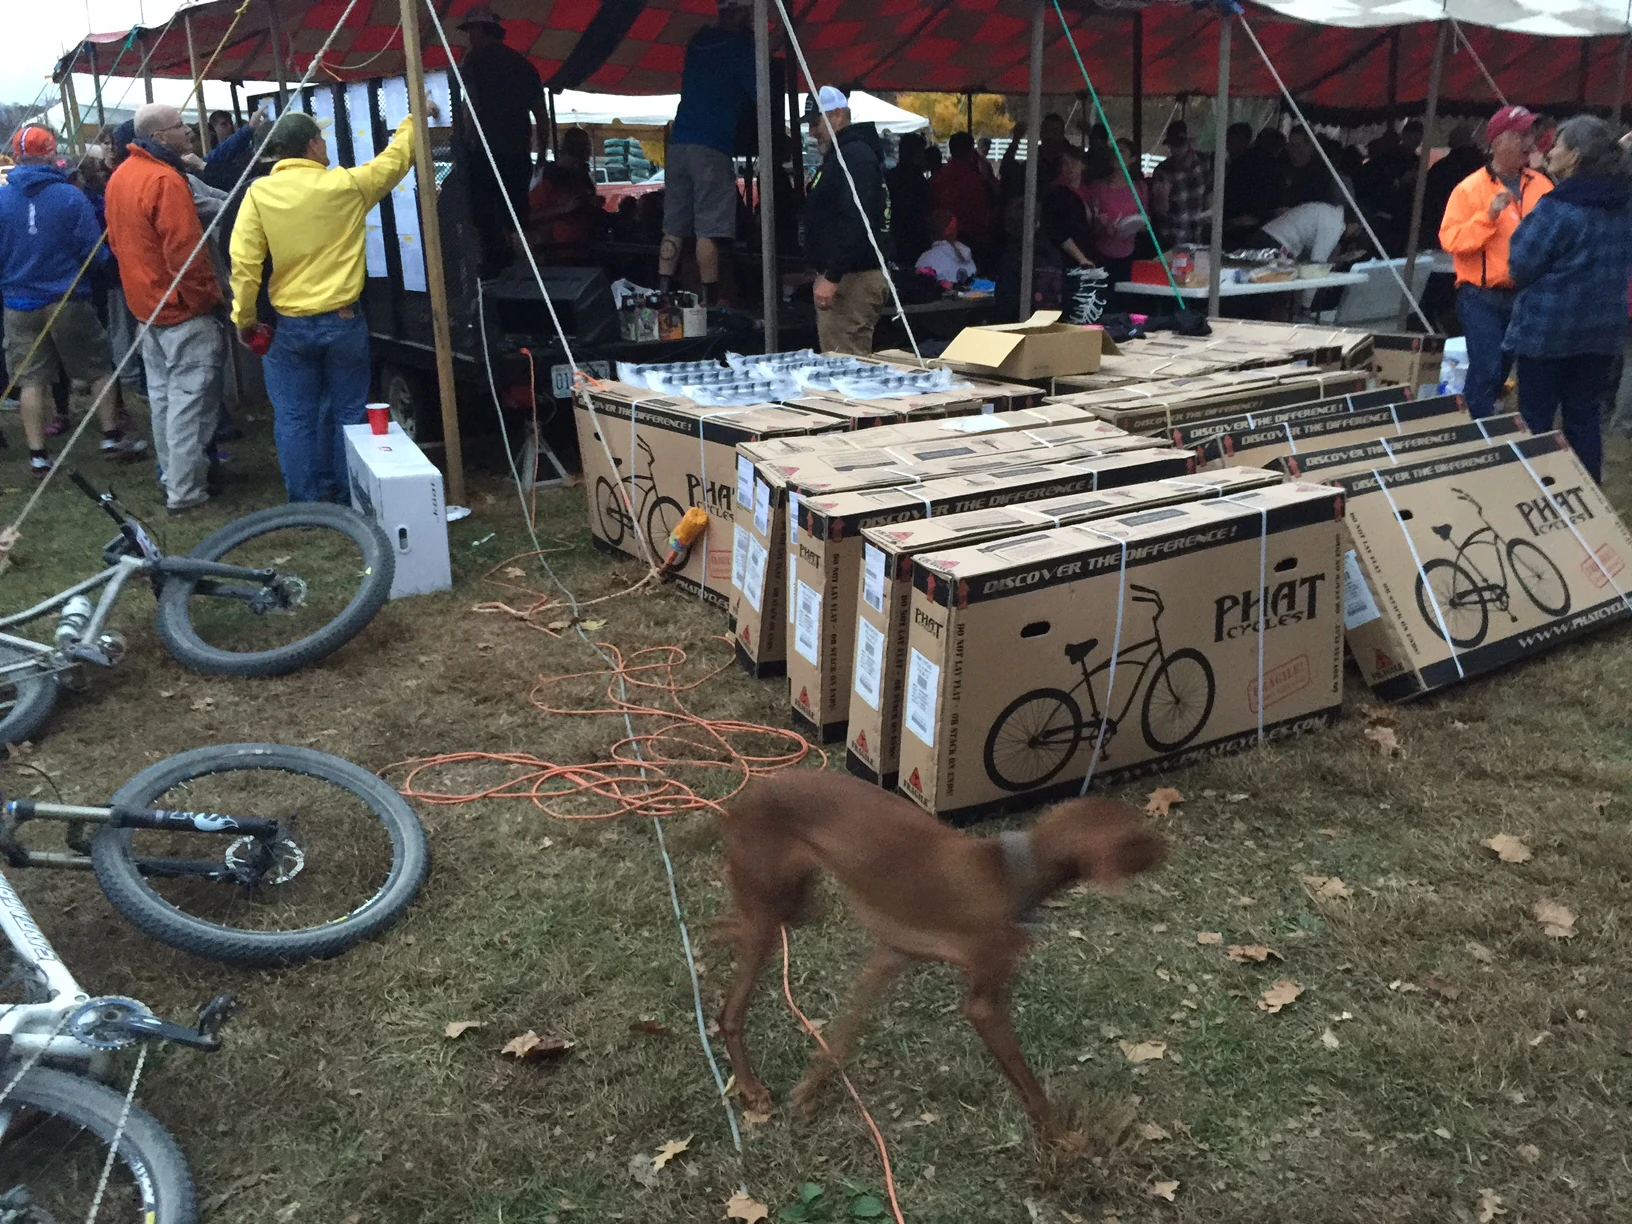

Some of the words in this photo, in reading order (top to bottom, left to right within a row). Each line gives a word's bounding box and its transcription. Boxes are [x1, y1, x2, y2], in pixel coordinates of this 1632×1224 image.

[1190, 421, 1249, 439] DISCOVER
[1303, 421, 1325, 434] THE
[1326, 411, 1391, 431] DIFFERENCE
[1305, 448, 1365, 467] DISCOVER
[1412, 466, 1433, 479] THE
[686, 473, 735, 511] PHA
[955, 497, 985, 513] THE
[1515, 485, 1594, 537] PHAT
[1355, 523, 1366, 540] NOT
[983, 561, 1081, 595] DISCOVER
[1088, 554, 1122, 571] THE
[1213, 572, 1326, 643] PHAT
[915, 607, 943, 639] PHAT
[956, 623, 965, 637] DO
[1226, 610, 1304, 639] CYCLES
[955, 638, 964, 658] NOT
[953, 660, 963, 678] LAY
[951, 679, 962, 702] FLAT
[948, 727, 958, 756] STACK
